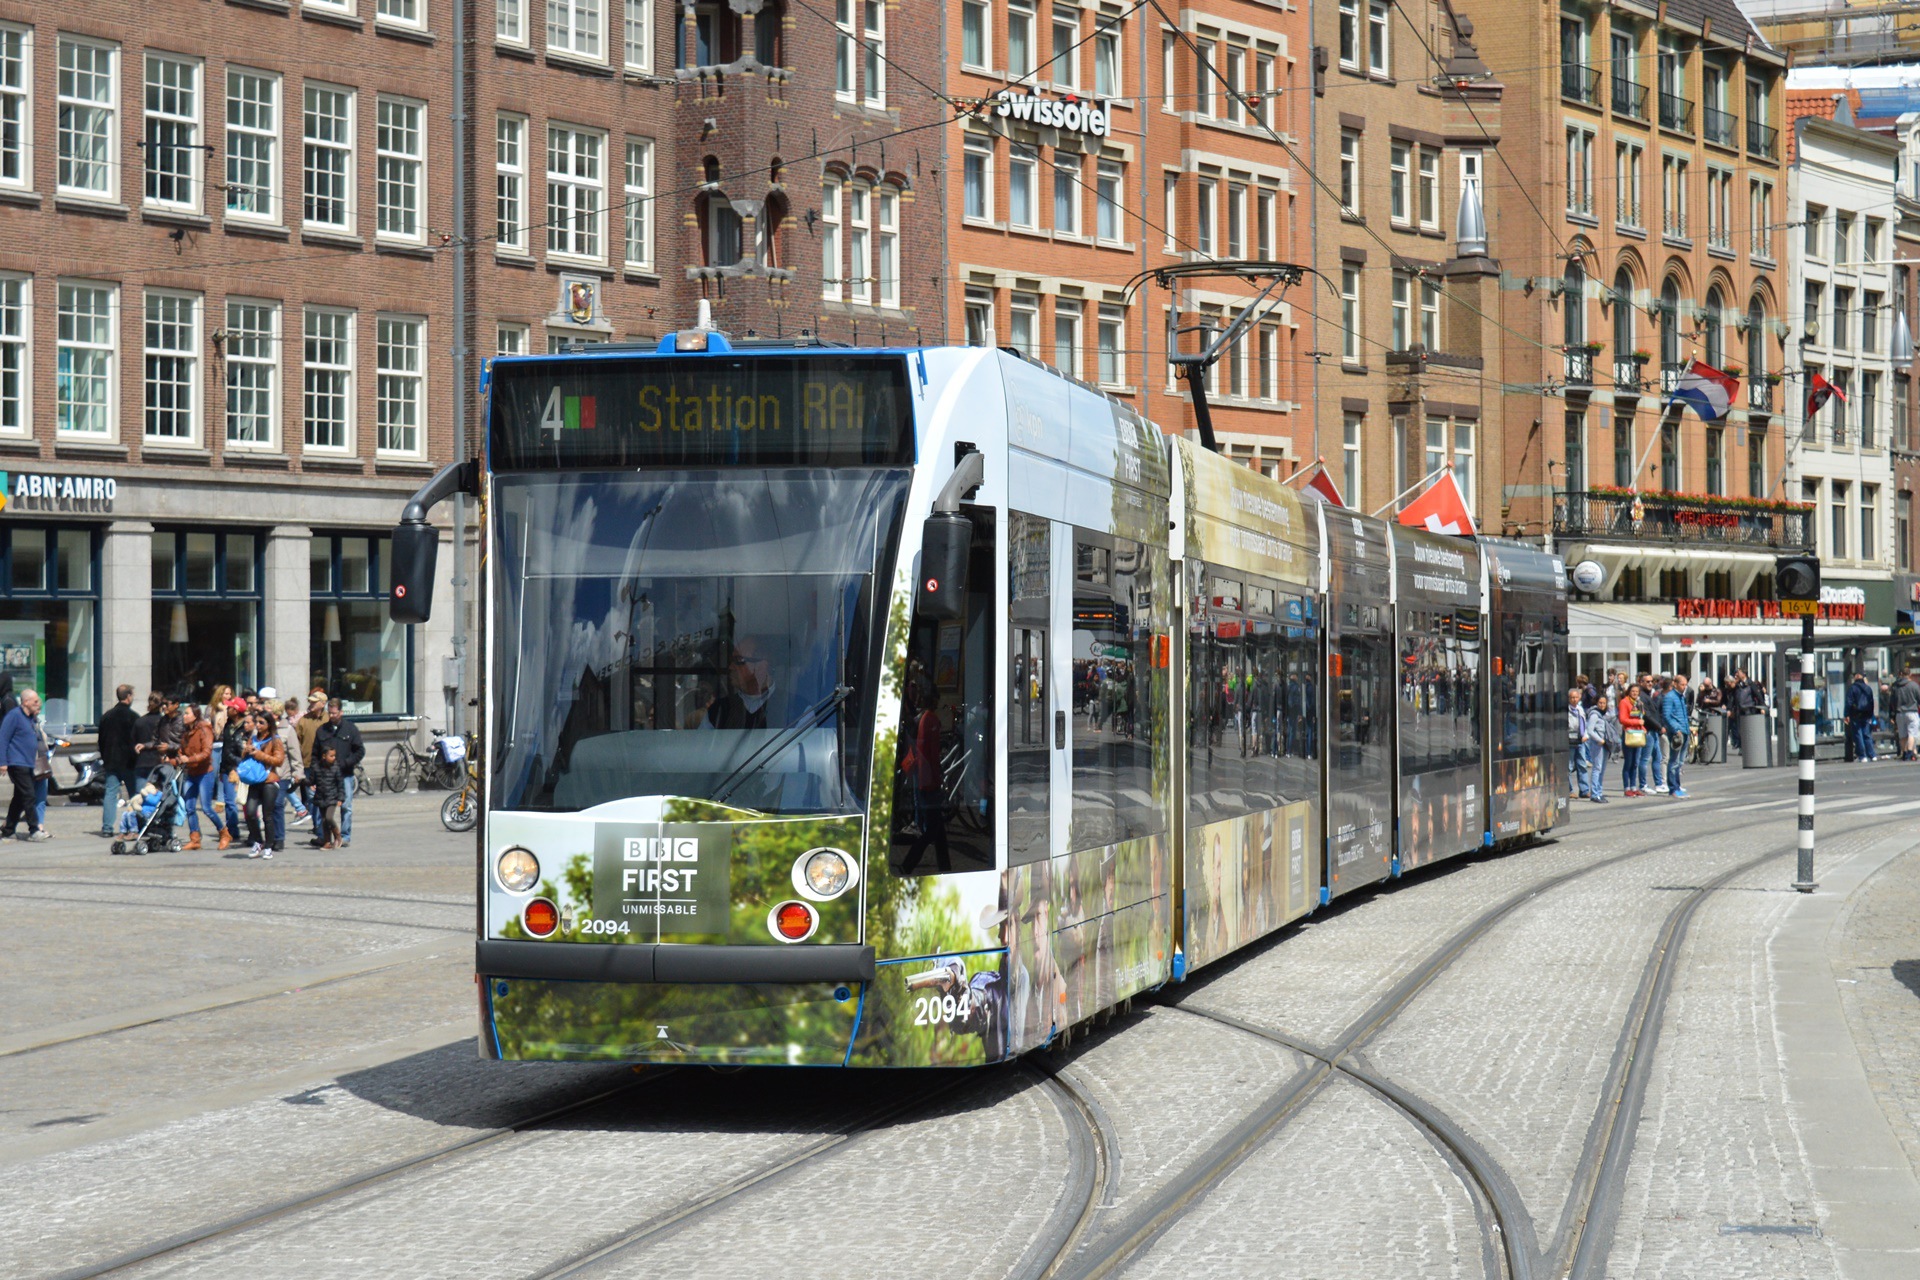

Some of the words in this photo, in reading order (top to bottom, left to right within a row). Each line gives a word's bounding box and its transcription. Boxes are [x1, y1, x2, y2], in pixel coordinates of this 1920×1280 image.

[540, 385, 564, 441] 4
[639, 384, 780, 431] Station
[803, 382, 864, 430] RAI
[1124, 453, 1141, 483] FIRST
[1674, 511, 1695, 526] HOTEL
[1678, 598, 1760, 619] RESTAURANT
[1788, 602, 1812, 613] 16-V
[624, 838, 699, 862] BBC
[623, 869, 698, 892] FIRST
[623, 905, 698, 915] UNMISSABLE
[581, 918, 631, 935] 2094
[914, 993, 971, 1026] 2094
